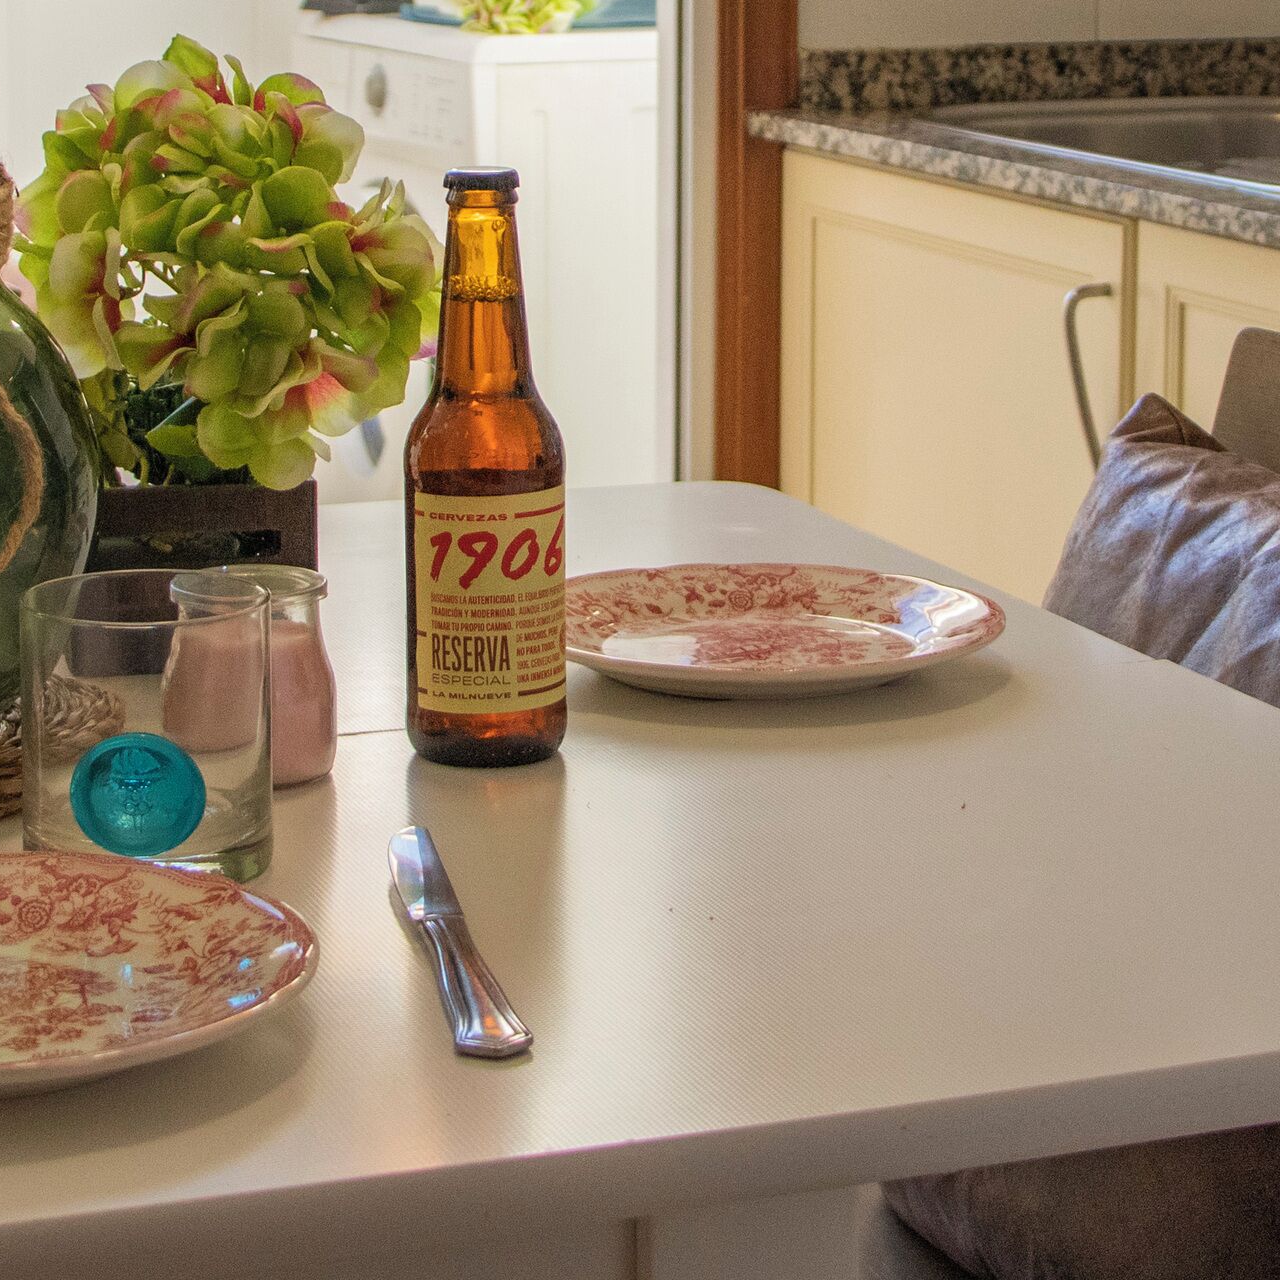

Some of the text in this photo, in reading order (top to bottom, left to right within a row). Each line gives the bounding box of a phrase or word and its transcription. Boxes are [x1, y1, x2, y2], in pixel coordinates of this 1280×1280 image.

[429, 512, 508, 522] CERVEZAS
[429, 513, 565, 590] 1906
[460, 595, 468, 605] LA
[517, 593, 523, 602] EL
[431, 606, 462, 618] TRADICIÓN
[464, 608, 470, 618] Y
[451, 621, 460, 631] TU
[461, 622, 485, 632] PROPIO
[431, 633, 510, 672] RESERVA
[516, 646, 525, 657] NO
[525, 643, 540, 655] PARA
[432, 672, 511, 686] ESPECIAL
[517, 673, 529, 683] UNA
[449, 692, 511, 700] MILNUEVE
